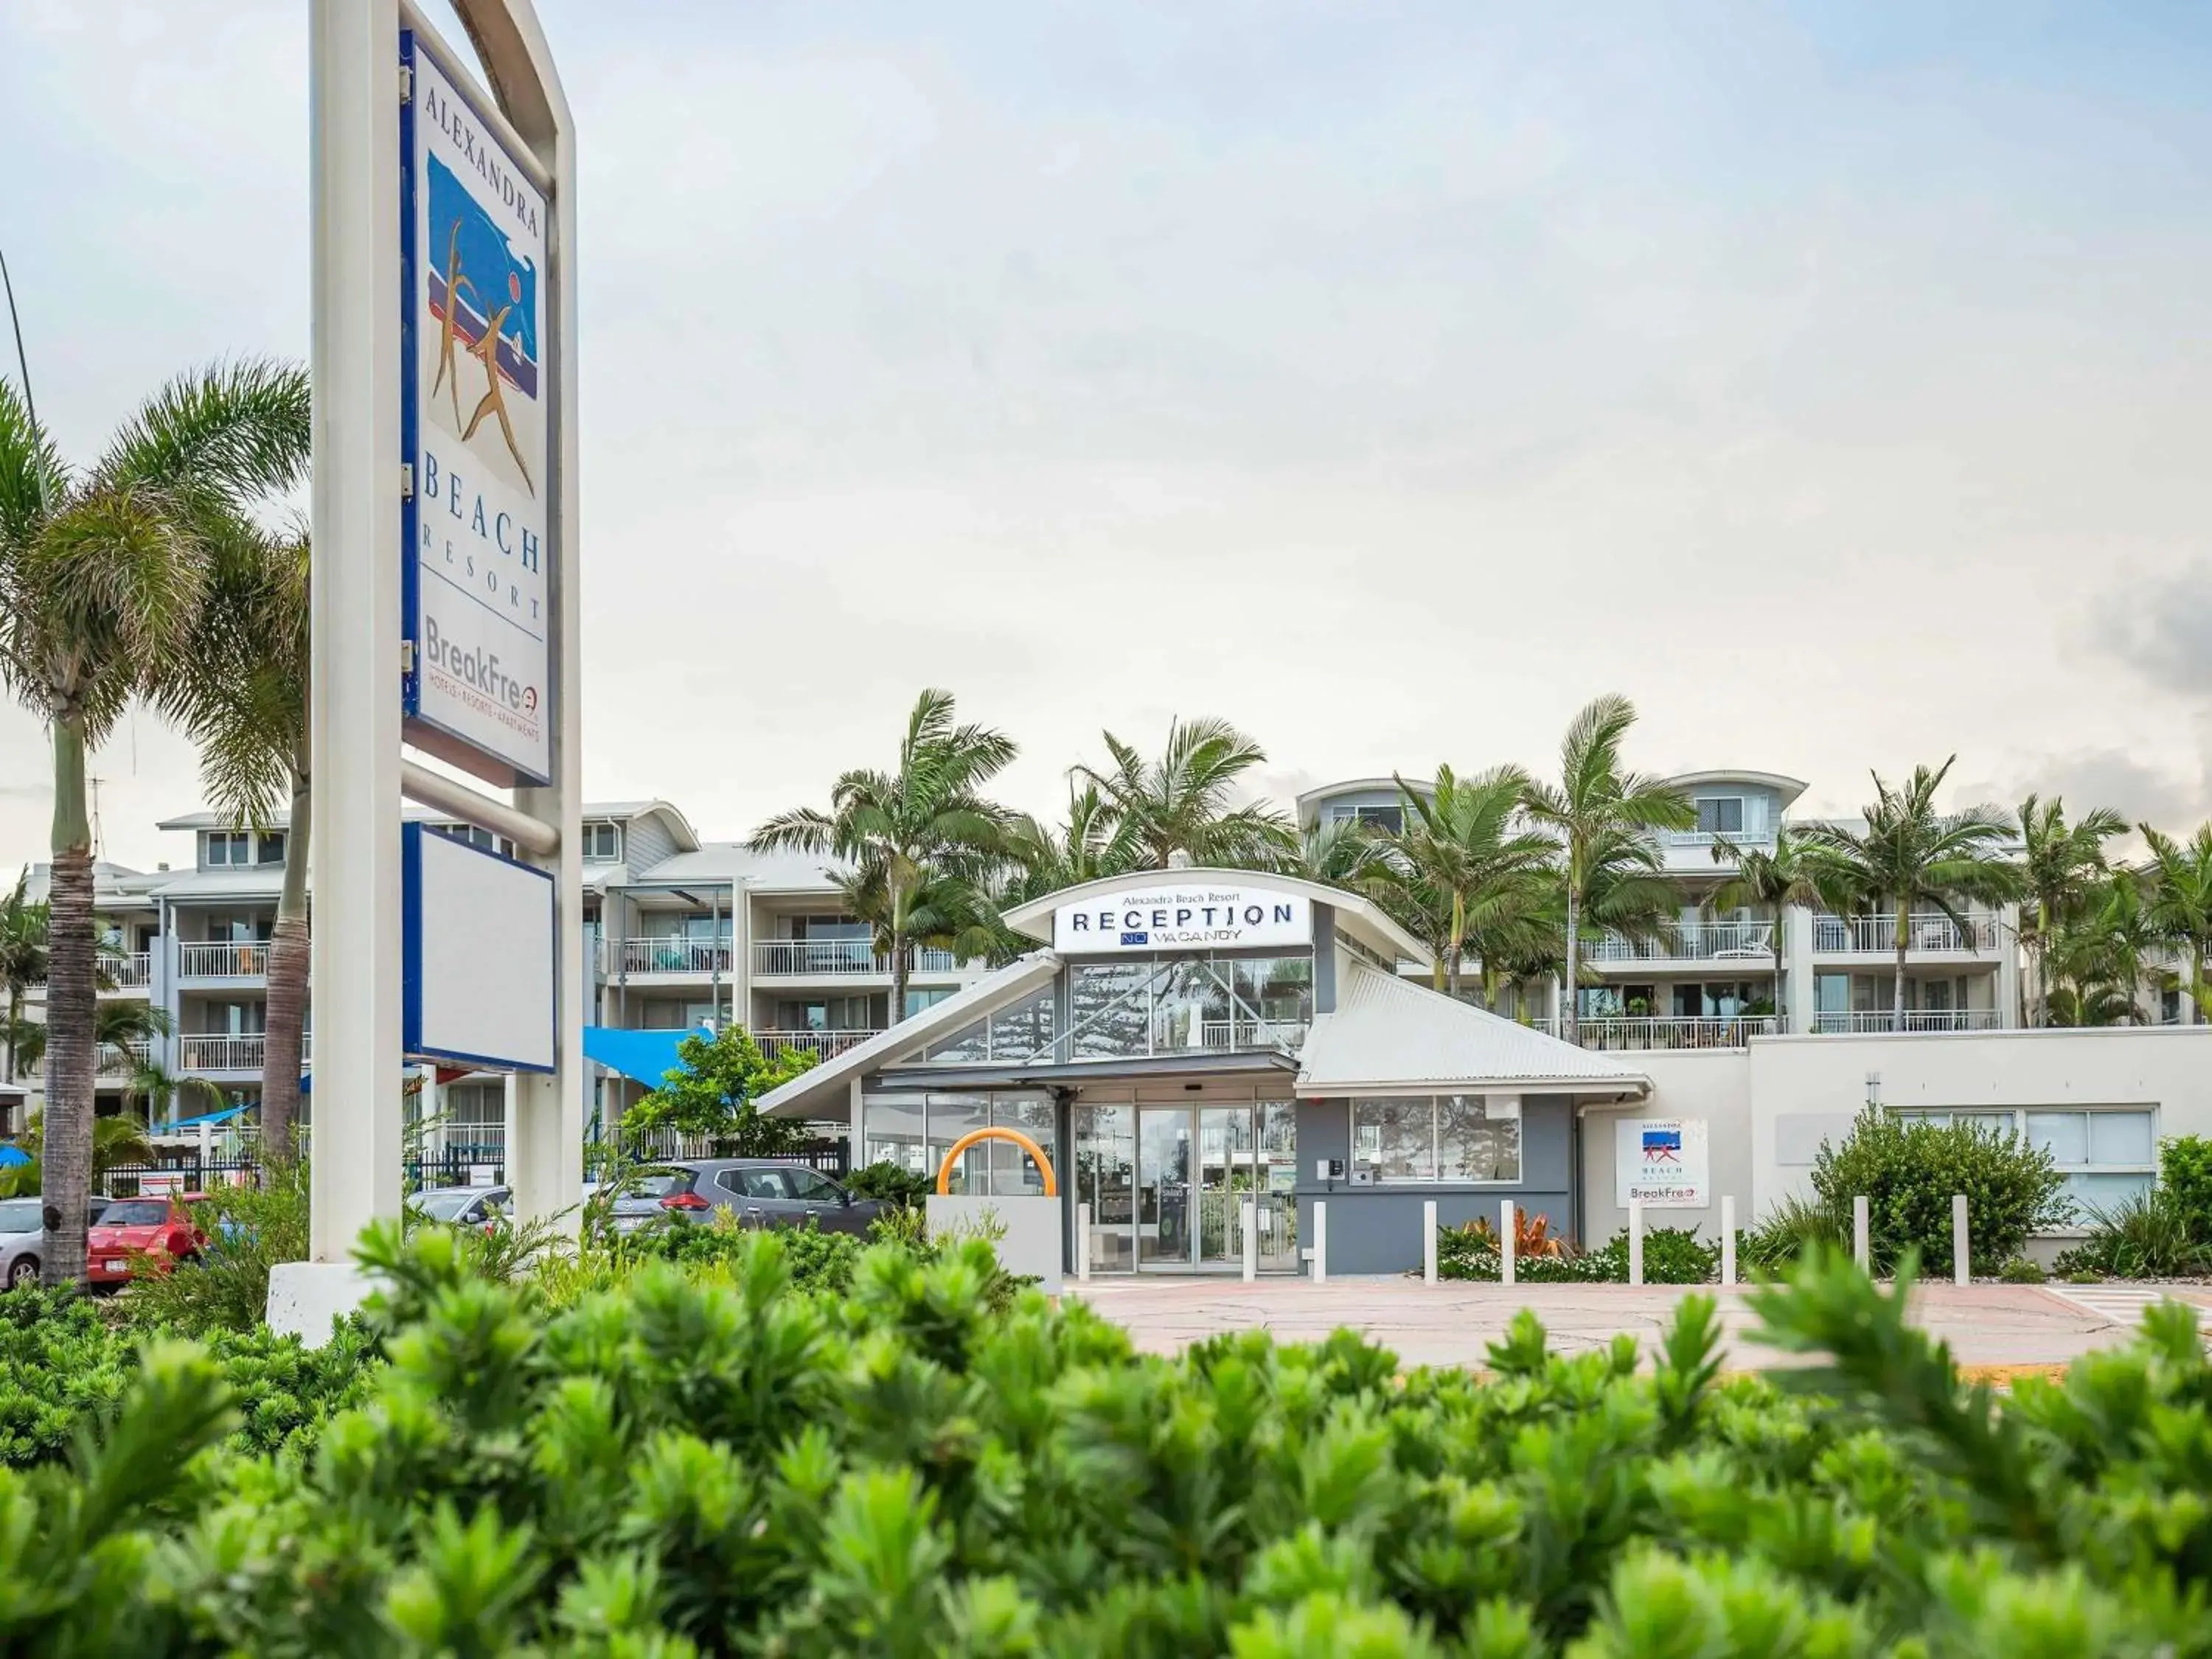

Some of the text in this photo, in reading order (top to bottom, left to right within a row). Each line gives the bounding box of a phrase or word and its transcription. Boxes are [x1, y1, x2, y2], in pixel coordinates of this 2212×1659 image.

[425, 86, 538, 238] ALEXANDRA
[424, 451, 539, 575] BEACH
[422, 522, 540, 618] RESORT
[1073, 904, 1291, 931] RECEPTION
[1123, 892, 1240, 905] Alexandra Beach Resort
[1121, 930, 1242, 944] NO VACANCY
